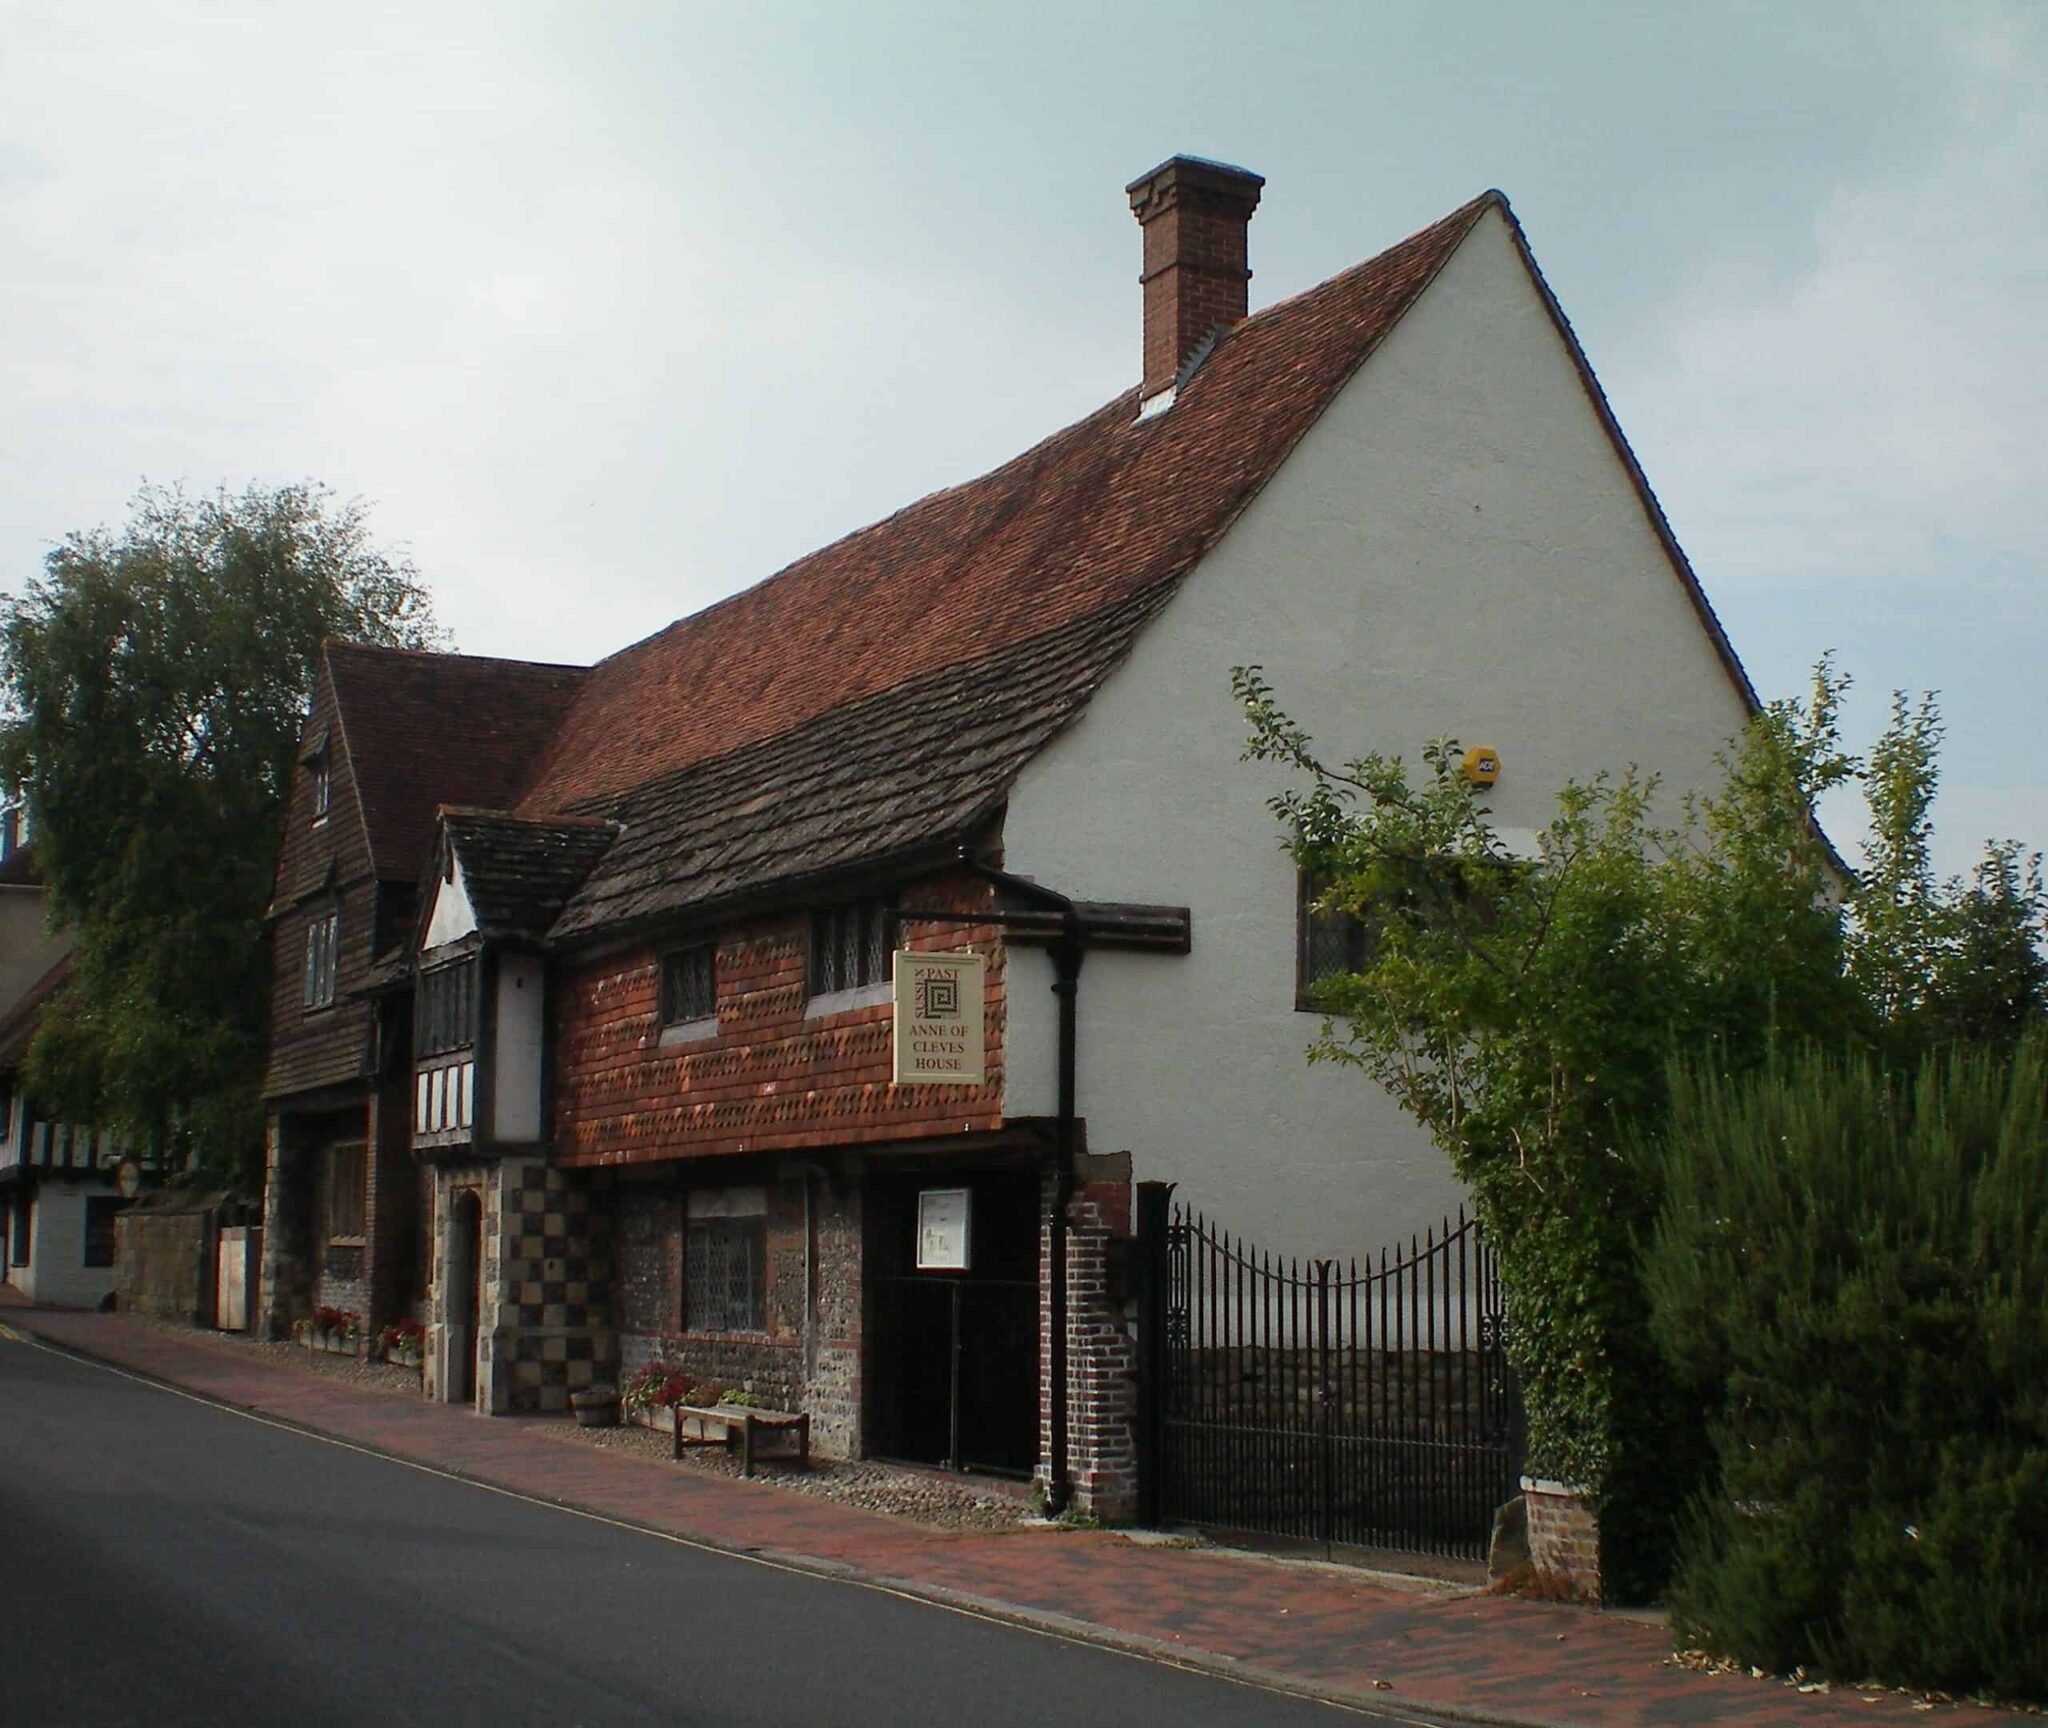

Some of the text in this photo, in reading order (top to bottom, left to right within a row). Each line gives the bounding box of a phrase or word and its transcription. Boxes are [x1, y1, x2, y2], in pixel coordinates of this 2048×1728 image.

[927, 968, 960, 979] PAST
[914, 968, 925, 1019] SUSSEX
[909, 1025, 969, 1037] ANNE OF
[913, 1042, 965, 1054] CLEVES
[915, 1058, 962, 1070] HOUSE
